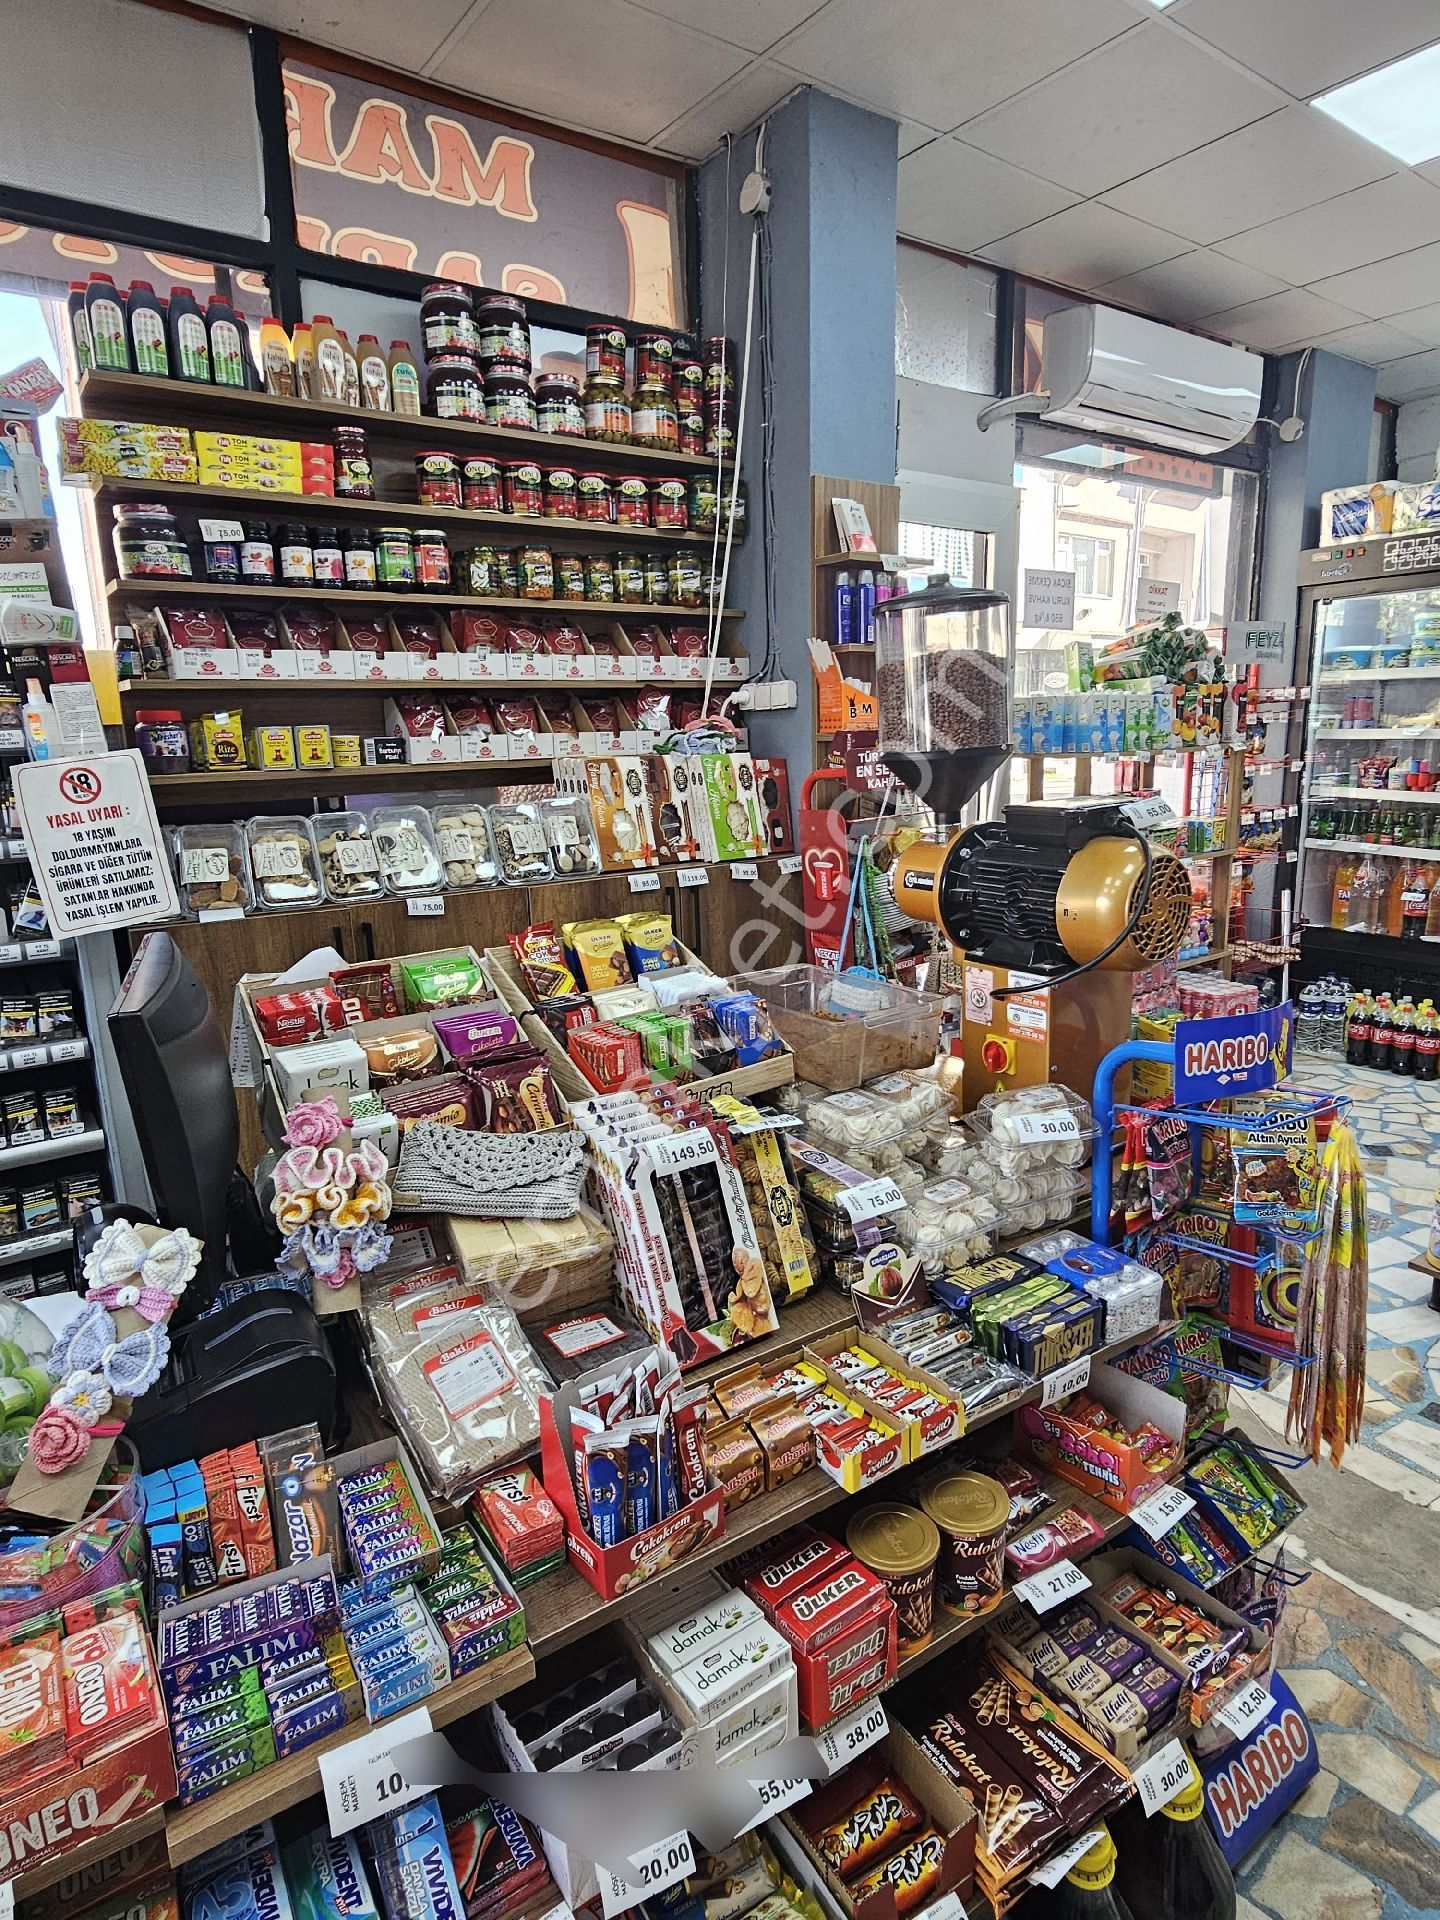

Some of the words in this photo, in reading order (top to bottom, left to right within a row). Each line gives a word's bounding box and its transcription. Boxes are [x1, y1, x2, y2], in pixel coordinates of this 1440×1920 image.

[235, 472, 249, 480] TON
[217, 745, 235, 753] Rize
[856, 766, 872, 777] EN
[47, 811, 85, 828] YASAL
[88, 805, 123, 822] UYARI
[1147, 804, 1172, 818] 65,00
[72, 832, 83, 843] 18
[86, 827, 117, 842] YAŞINI
[52, 838, 142, 862] DOLDURMAYANLARA
[49, 863, 83, 878] SİGARA
[85, 862, 97, 871] VE
[99, 855, 125, 870] DİĞER
[126, 851, 153, 864] TÜTÜN
[56, 874, 100, 893] ÜRÜNLERİ
[64, 889, 110, 906] SATANLAR
[111, 881, 155, 898] HAKKINDA
[65, 908, 96, 922] YASAL
[97, 901, 124, 918] İŞLEM
[277, 1016, 305, 1029] Nestlé
[468, 1026, 502, 1040] ÜLKER
[471, 1036, 503, 1053] Çikolata
[1184, 1033, 1269, 1077] HARIBO
[388, 1052, 422, 1069] Çikolata
[1041, 1120, 1076, 1135] 30,00
[1248, 1133, 1275, 1145] Altın
[1277, 1132, 1308, 1146] Ayıcık
[672, 1140, 715, 1164] 149,50
[867, 1188, 902, 1209] 75,00
[1060, 1371, 1088, 1392] 10,00
[340, 1473, 382, 1494] FALIM
[493, 1475, 531, 1504] First
[240, 1485, 264, 1523] First
[348, 1493, 391, 1514] FALIM
[1158, 1492, 1187, 1517] 15,00
[355, 1513, 398, 1535] FALIM
[363, 1529, 407, 1552] FALIM
[1015, 1532, 1047, 1556] Nesfit
[221, 1541, 243, 1577] First
[372, 1545, 419, 1571] FALIM
[761, 1540, 832, 1589] ÜLKER
[1047, 1569, 1083, 1594] 27,00
[277, 1583, 292, 1618] FALIM
[311, 1579, 326, 1615] FALIM
[792, 1571, 866, 1621] ÜLKER
[208, 1607, 222, 1643] FALIM
[243, 1596, 258, 1633] FALIM
[175, 1618, 188, 1655] FALIM
[351, 1617, 397, 1643] FALIM
[671, 1616, 722, 1654] damak
[210, 1632, 299, 1680] FALIM
[360, 1643, 406, 1671] FALIM
[458, 1631, 504, 1662] FALIM
[1188, 1647, 1212, 1671] Piko
[270, 1646, 321, 1677] FALIM
[697, 1649, 748, 1691] damak
[1064, 1660, 1093, 1690] Lifalif
[1212, 1654, 1228, 1674] Piko
[76, 1662, 109, 1726] ONEO
[180, 1685, 233, 1713] FALIM
[277, 1677, 329, 1708] FALIM
[377, 1672, 428, 1706] FALIM
[1238, 1687, 1267, 1718] 12,50
[1101, 1690, 1132, 1722] Lifalif
[183, 1709, 238, 1741] FALIM
[284, 1704, 338, 1744] FALIM
[845, 1710, 884, 1749] 38,00
[930, 1718, 993, 1784] Rulokat
[1006, 1723, 1077, 1791] Rulokat
[186, 1751, 247, 1791] FALIM
[1161, 1759, 1190, 1792] 30,00
[1207, 1708, 1310, 1838] HARIBO
[348, 1774, 359, 1812] MARKET
[640, 1843, 691, 1885] 20,00
